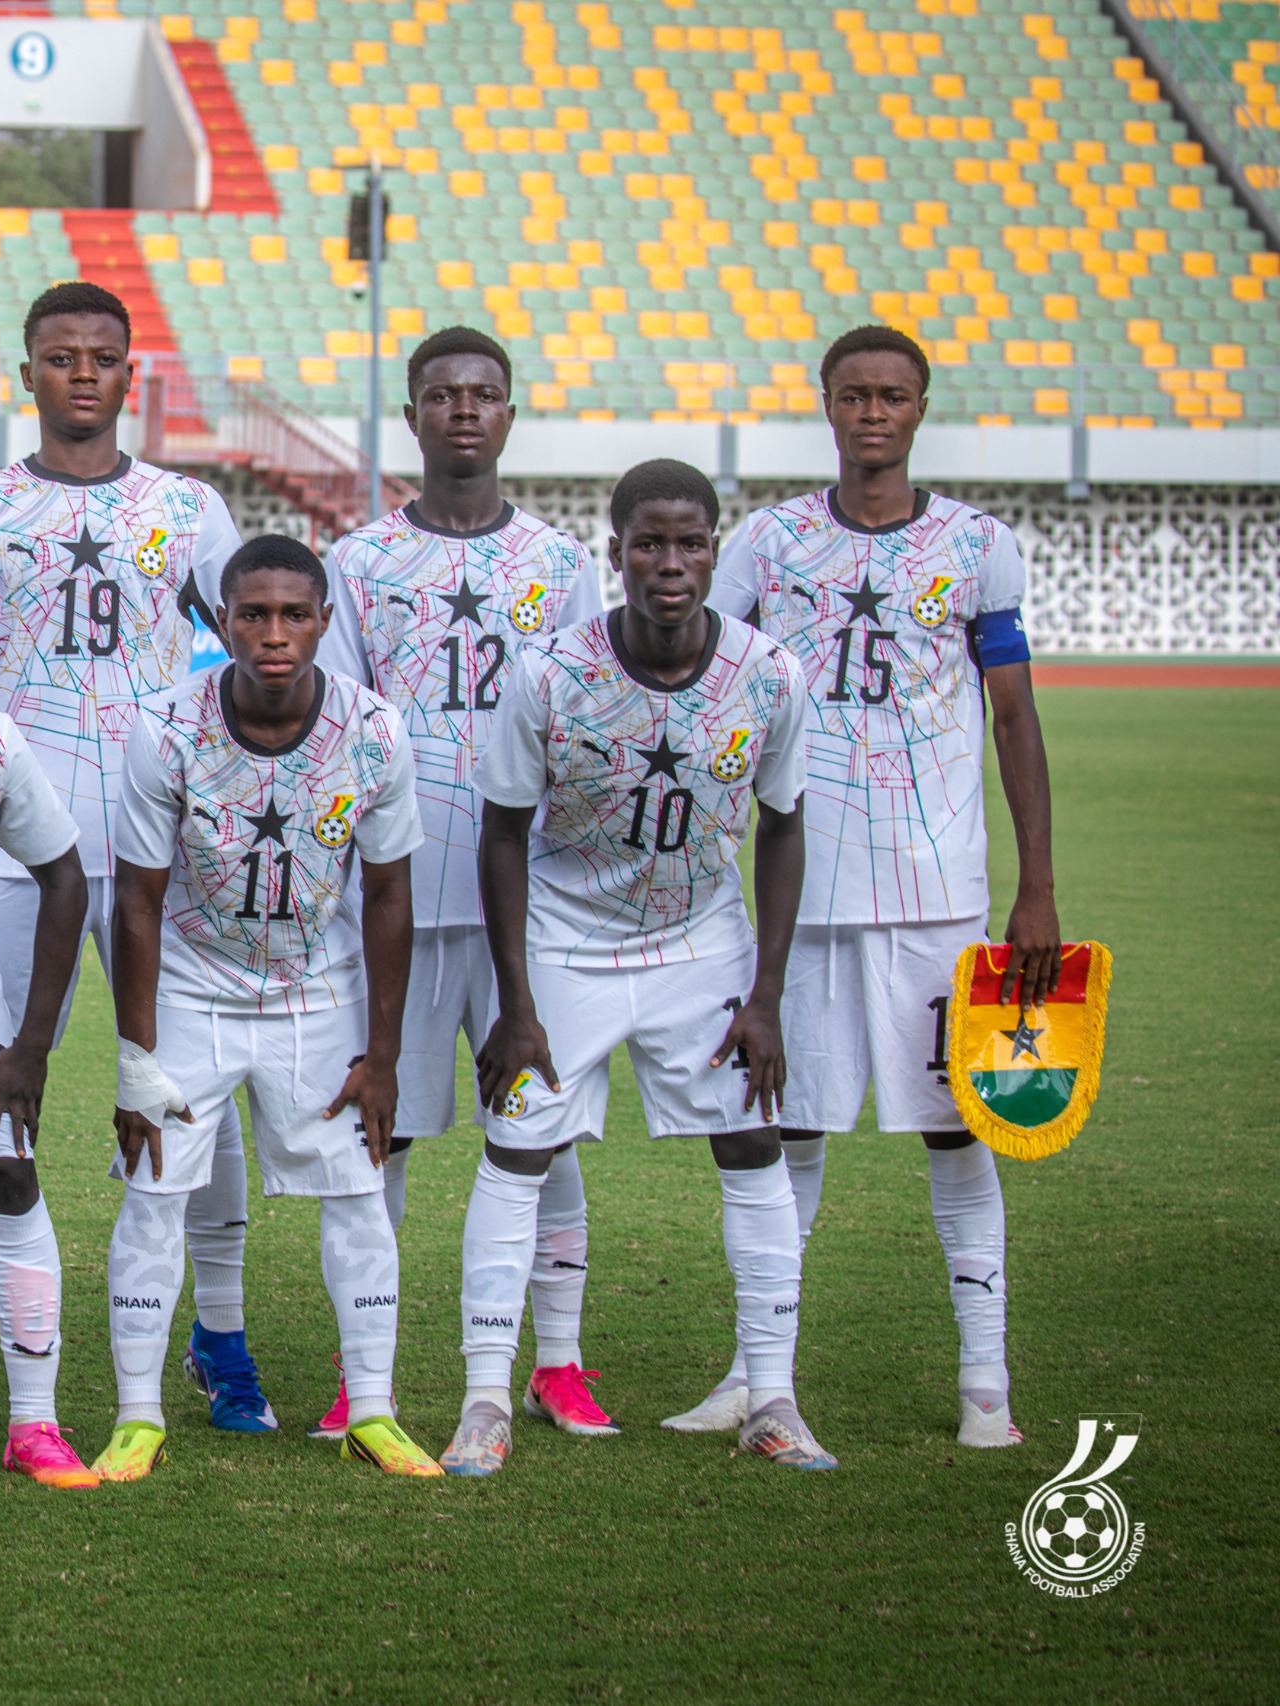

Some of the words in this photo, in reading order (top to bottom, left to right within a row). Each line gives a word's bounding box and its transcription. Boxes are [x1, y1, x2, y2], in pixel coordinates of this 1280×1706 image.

[18, 36, 47, 76] 9
[55, 579, 121, 656] 19
[440, 634, 505, 712] 12
[825, 630, 897, 704] 15
[621, 785, 694, 853] 10
[234, 850, 295, 920] 11
[113, 1295, 161, 1309] GHANA
[354, 1294, 397, 1309] GHANA
[471, 1315, 514, 1328] GHANA
[774, 1302, 800, 1314] GHA
